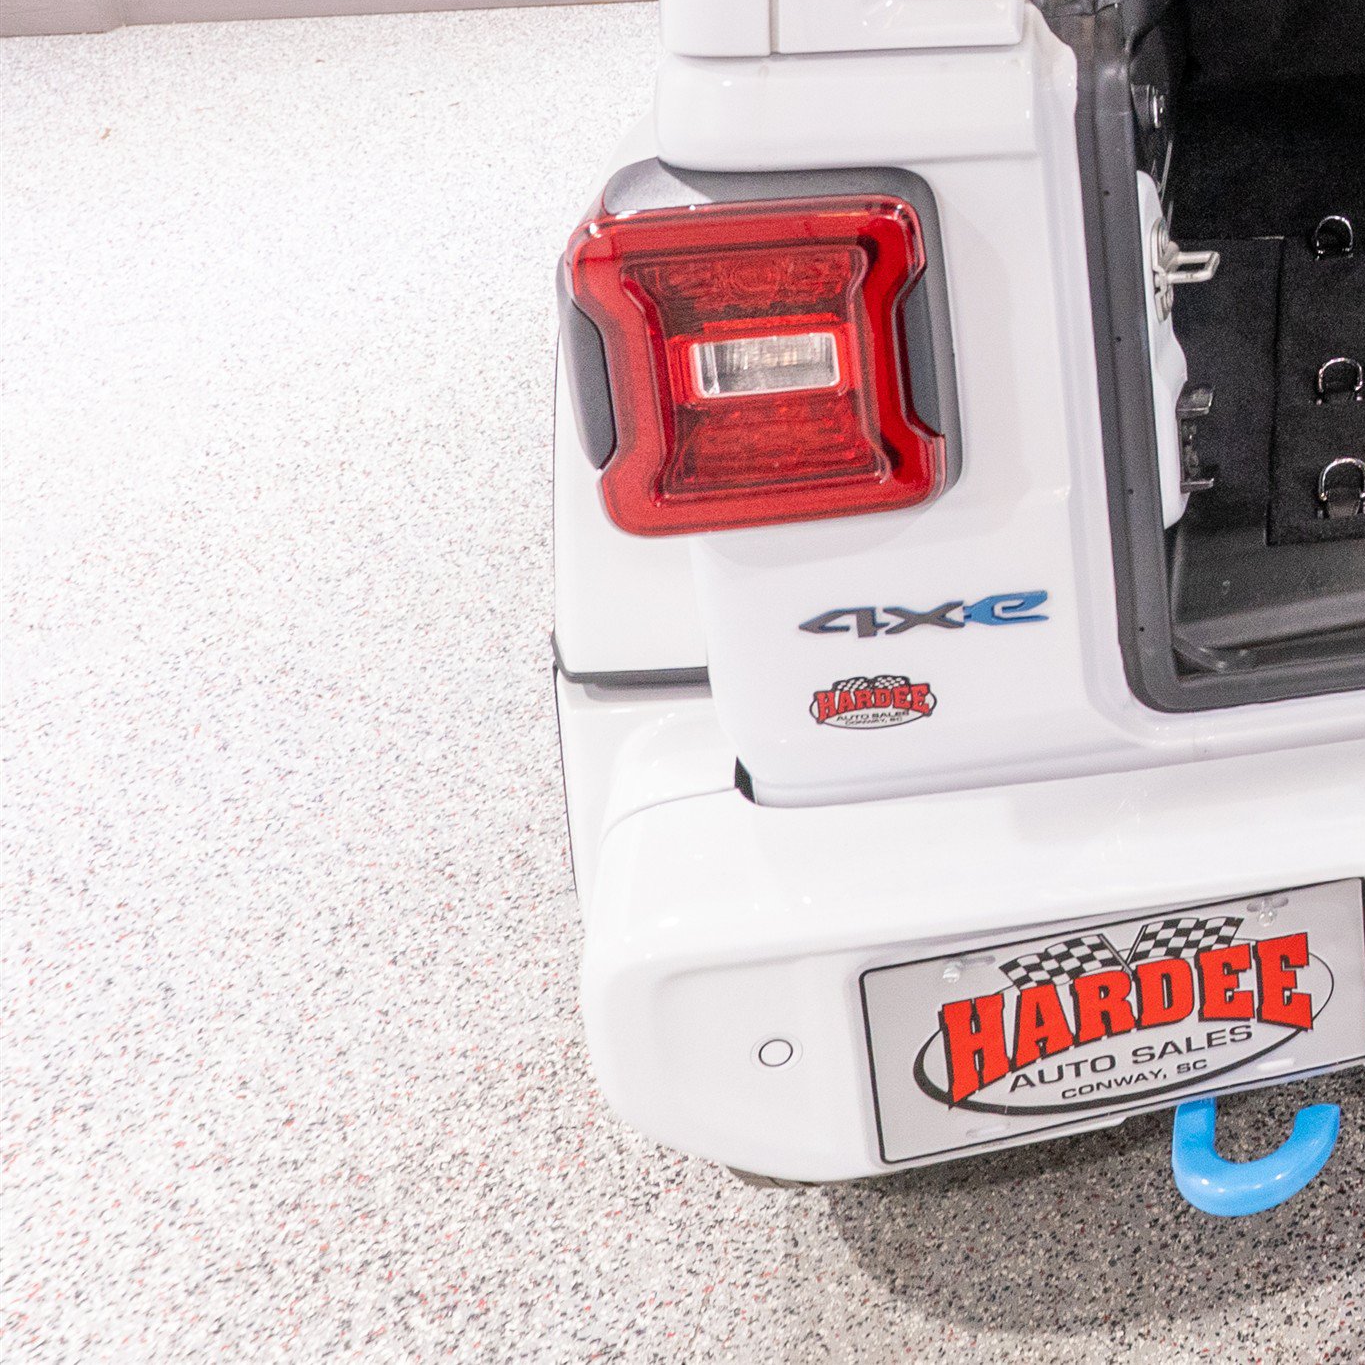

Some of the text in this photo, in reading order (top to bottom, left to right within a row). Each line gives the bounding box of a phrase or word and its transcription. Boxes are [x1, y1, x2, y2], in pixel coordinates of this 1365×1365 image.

[815, 683, 932, 723] HARDEE
[836, 710, 910, 722] AUTO SALES
[938, 932, 1314, 1109] HARDEE
[1008, 1023, 1254, 1094] AUTO SALES
[1061, 1058, 1209, 1100] CONWAY, SC
